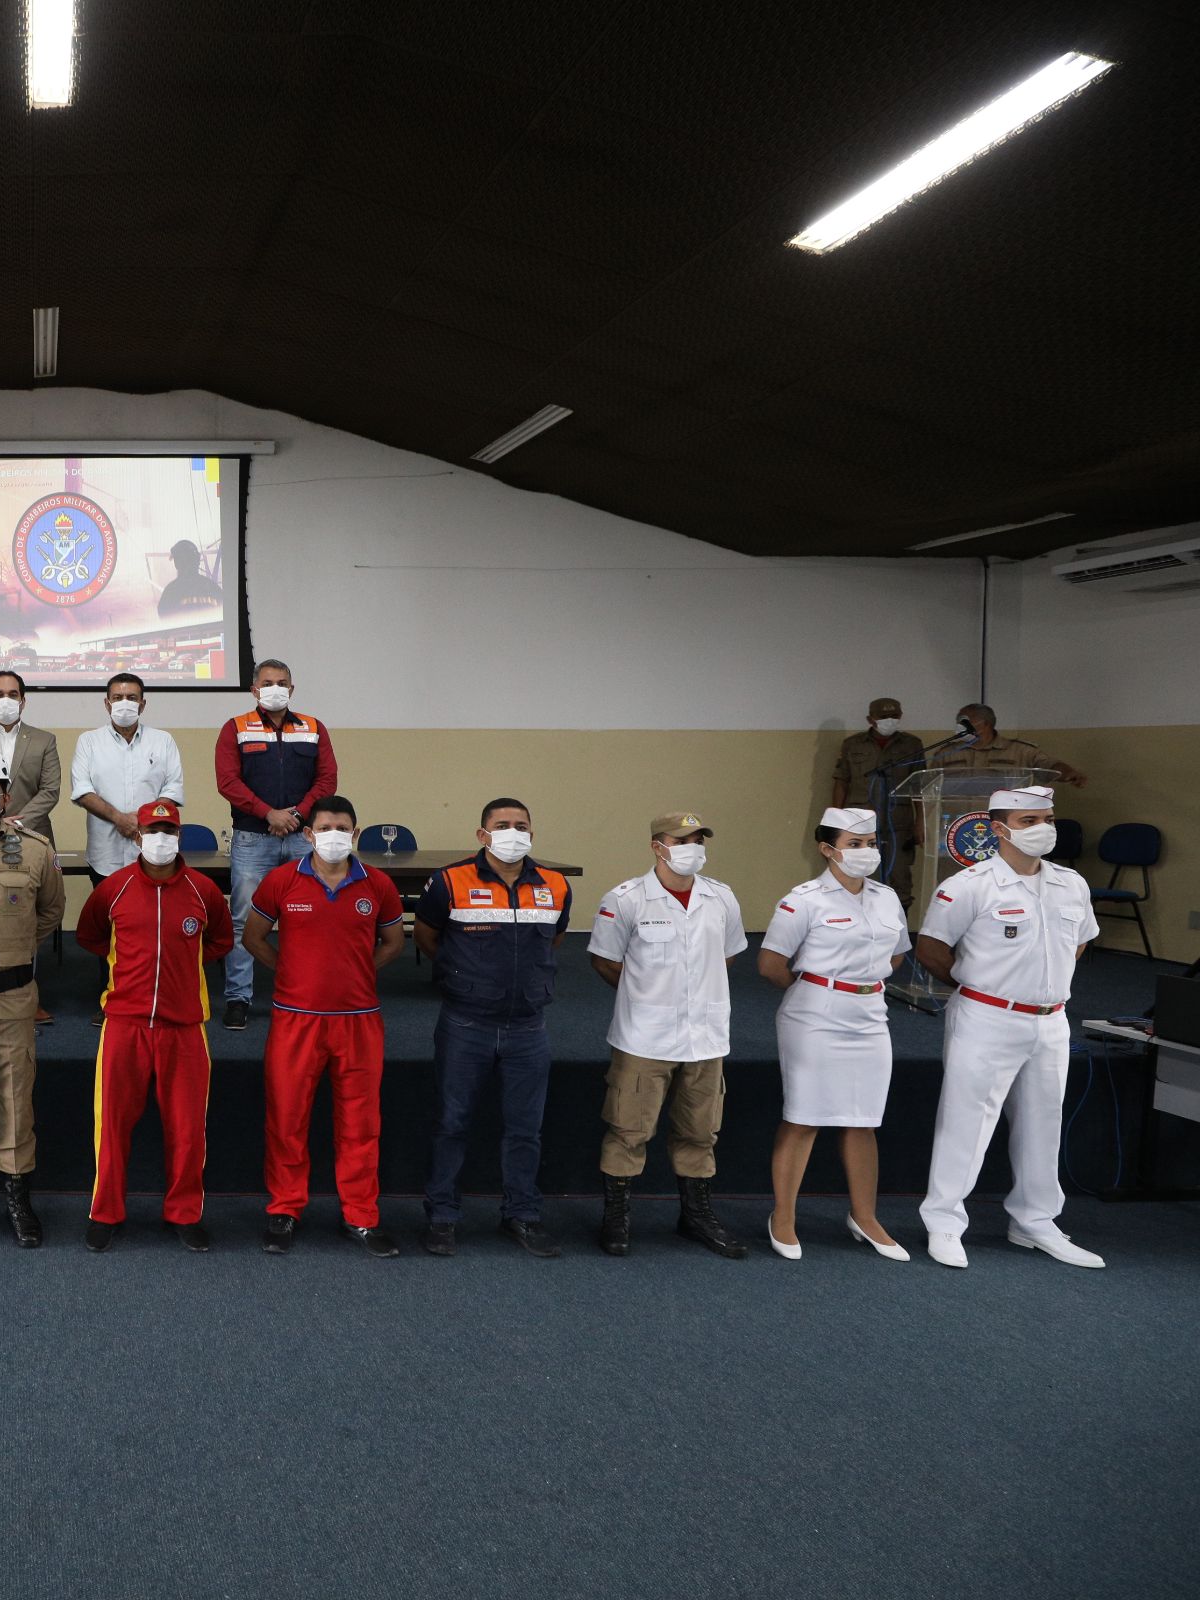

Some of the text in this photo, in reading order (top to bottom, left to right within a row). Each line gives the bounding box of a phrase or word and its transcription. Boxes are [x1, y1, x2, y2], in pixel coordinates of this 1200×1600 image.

[16, 496, 113, 584] CORPO DE BOMBEIROS MILITAR DO AMAZONAS
